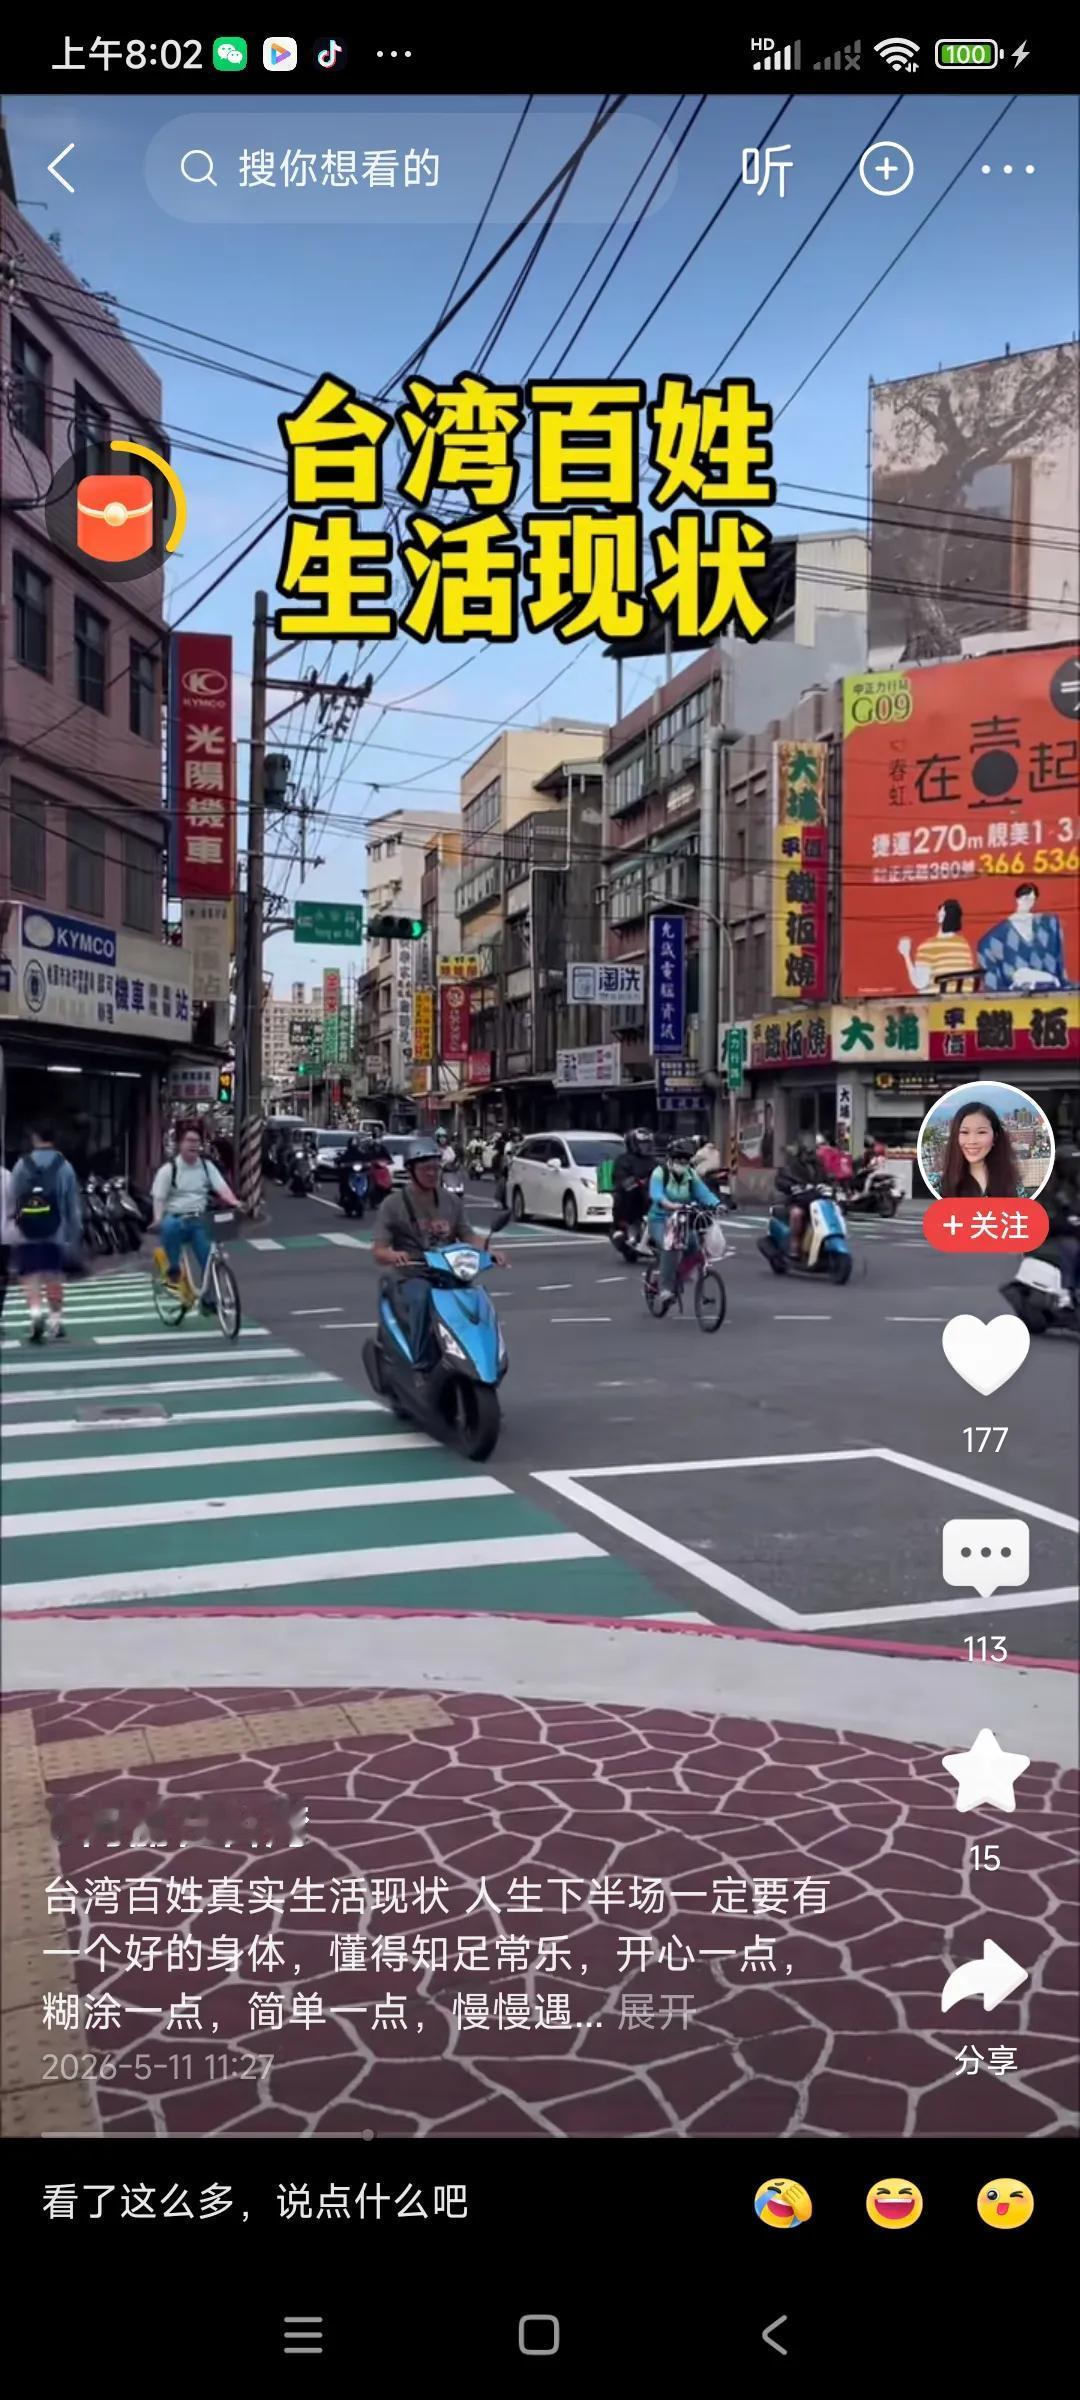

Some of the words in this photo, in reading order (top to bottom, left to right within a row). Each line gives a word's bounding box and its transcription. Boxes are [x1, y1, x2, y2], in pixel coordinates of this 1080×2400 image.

[183, 698, 227, 709] KYMCO
[852, 693, 911, 725] G09
[185, 723, 225, 866] 光陽機車
[56, 927, 115, 959] KYMCO
[598, 966, 640, 992] 淘洗
[840, 1013, 921, 1052] 大埔
